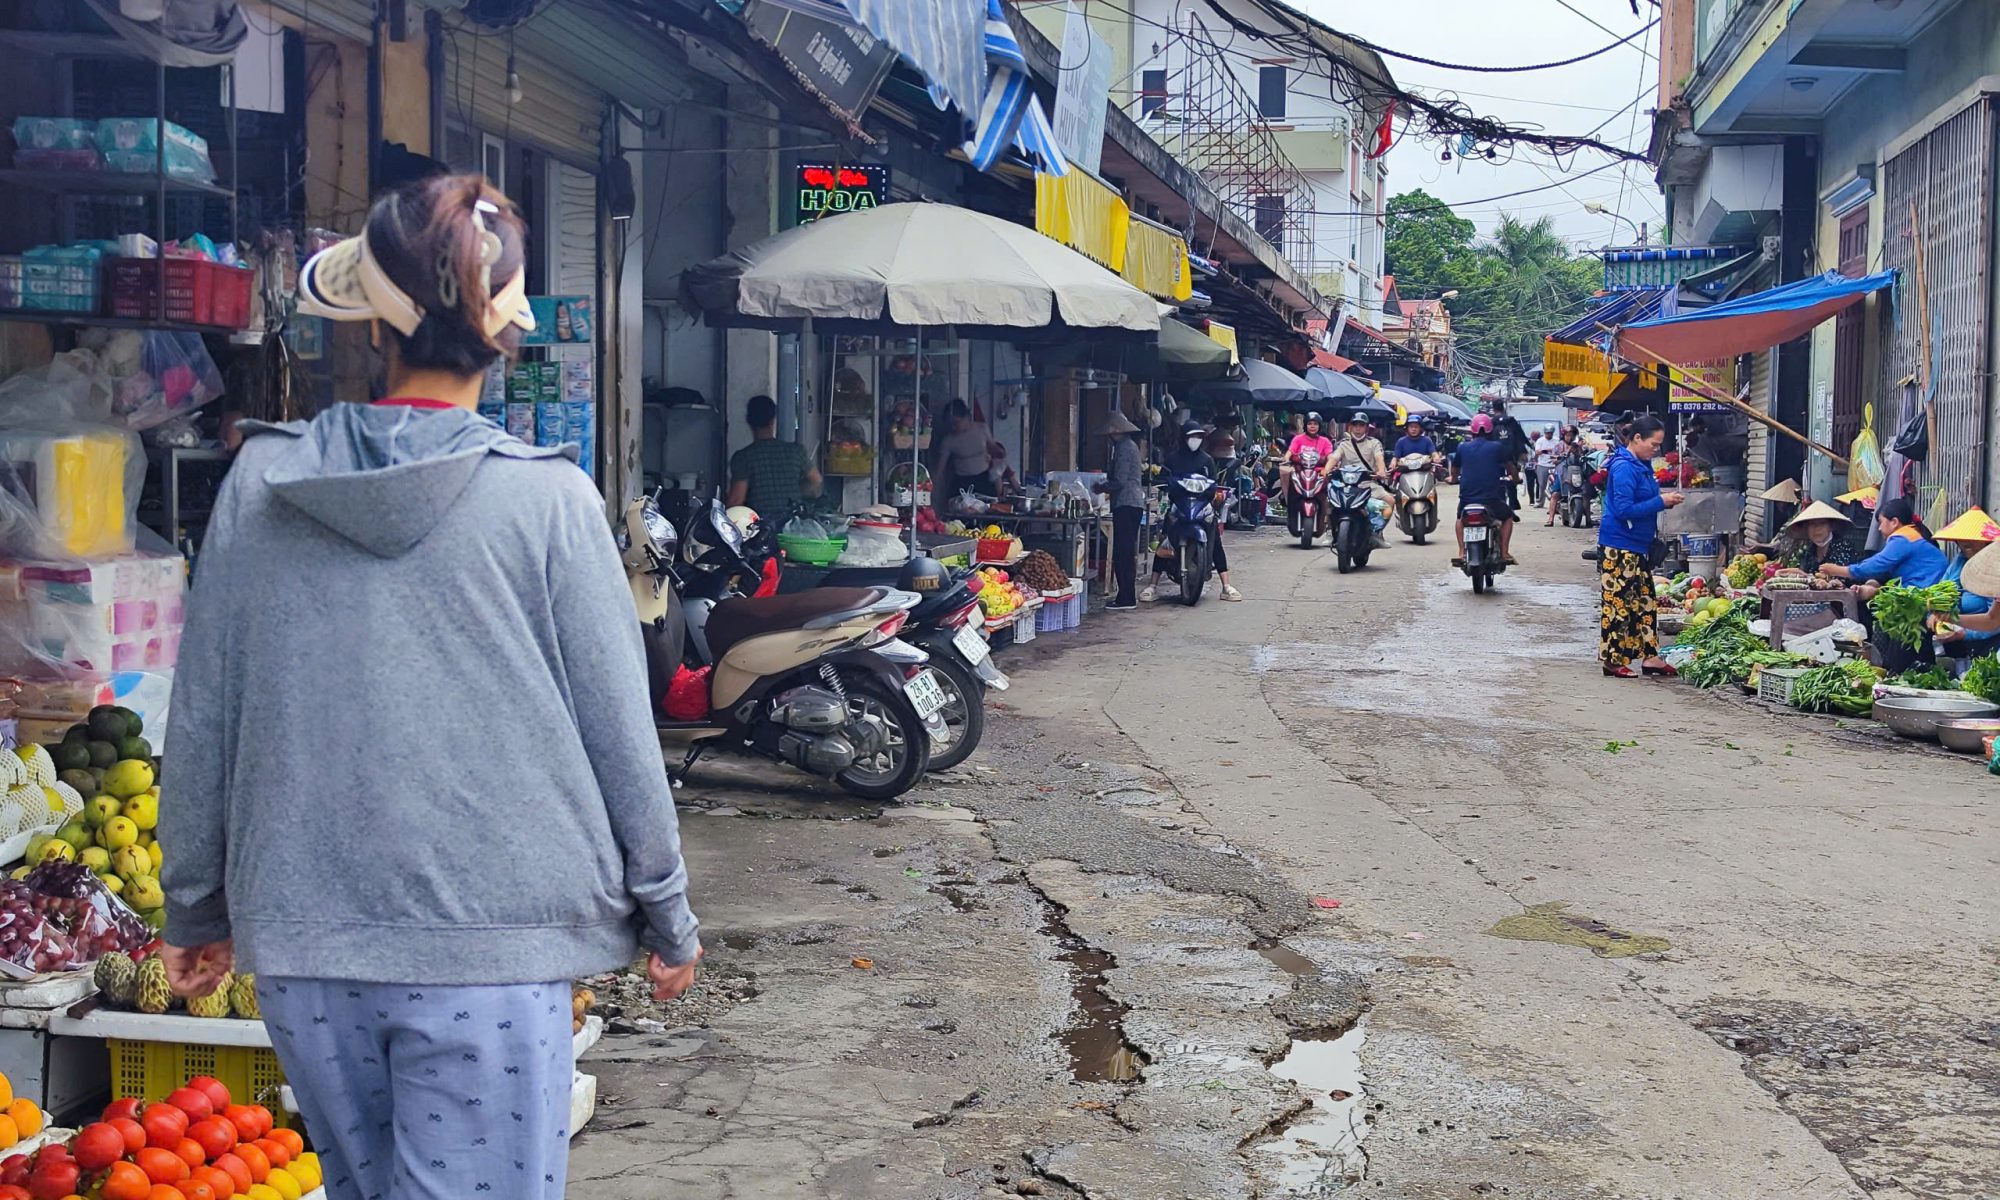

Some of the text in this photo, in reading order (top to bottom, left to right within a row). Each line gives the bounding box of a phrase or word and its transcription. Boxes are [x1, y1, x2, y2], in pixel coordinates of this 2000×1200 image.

[1059, 104, 1076, 149] HUY
[801, 189, 877, 212] HOA
[917, 688, 944, 714] 100.36
